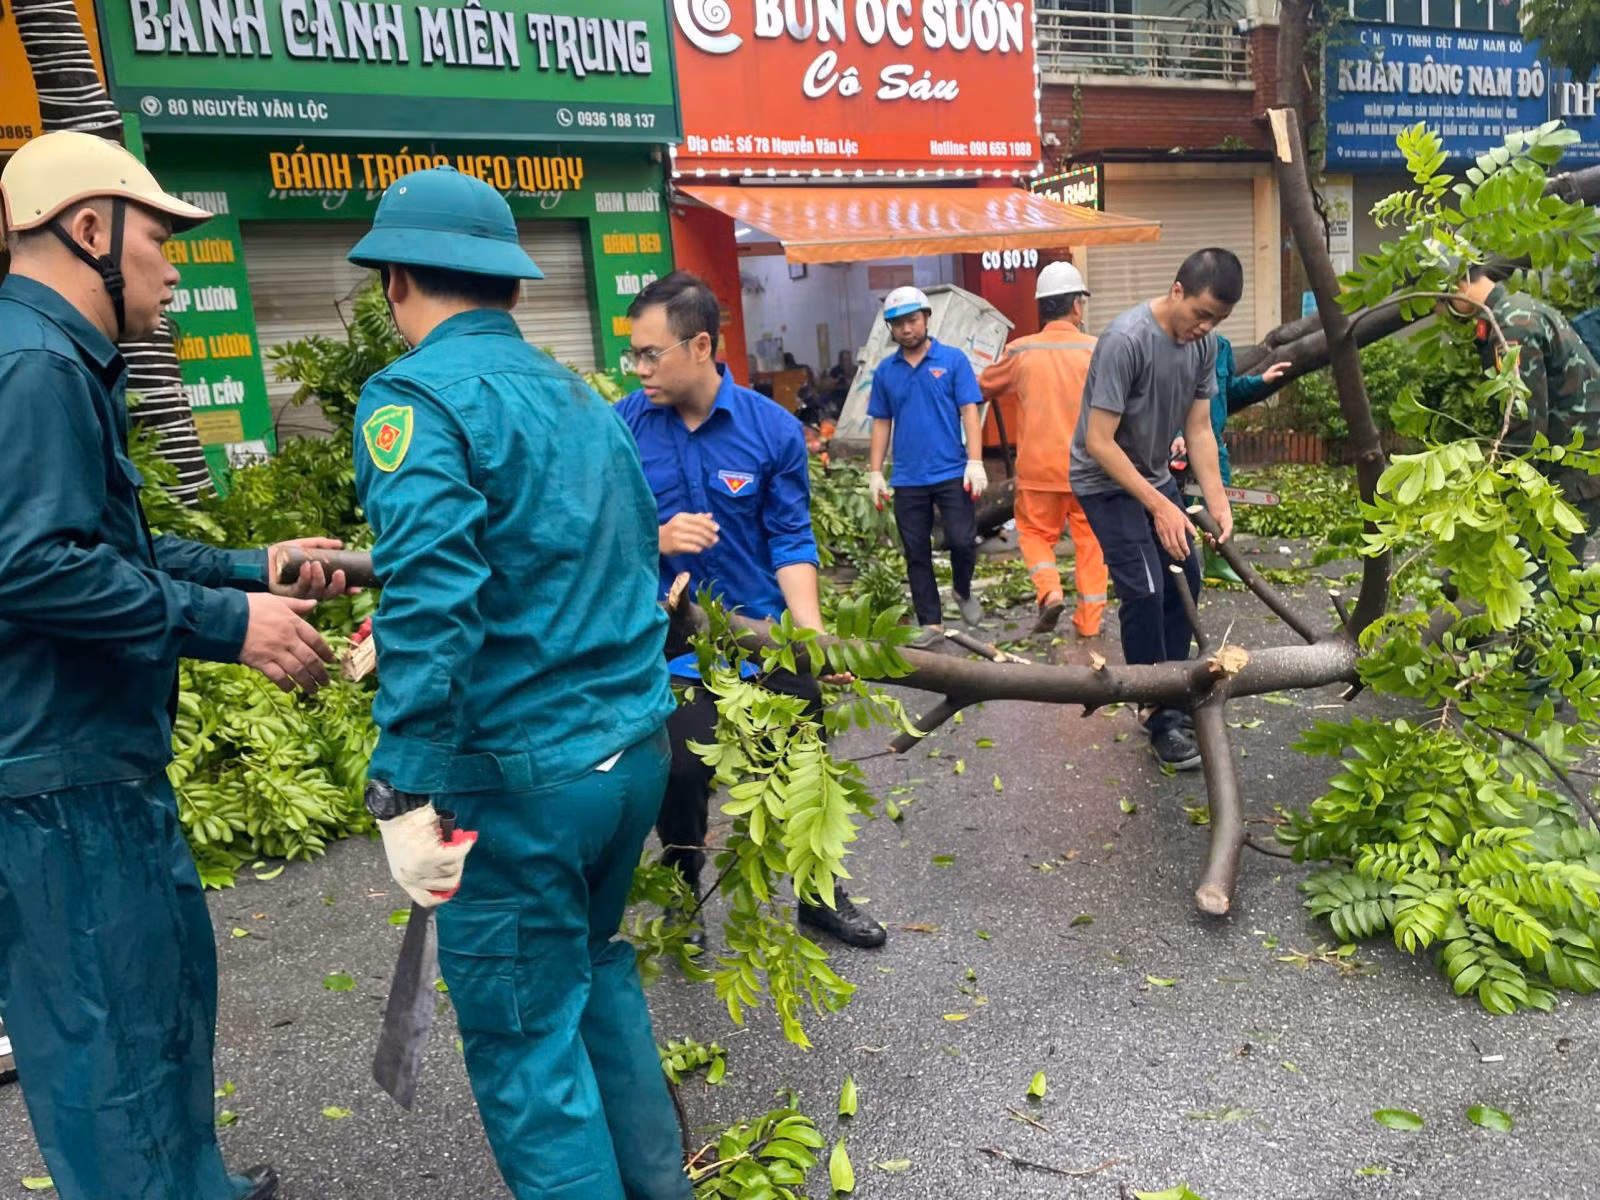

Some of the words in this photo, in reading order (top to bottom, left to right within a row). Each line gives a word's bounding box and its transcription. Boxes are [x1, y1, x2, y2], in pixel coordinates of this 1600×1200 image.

[1391, 33, 1403, 46] TY
[1407, 34, 1431, 48] TNHH
[1458, 36, 1478, 51] MAY
[1483, 39, 1505, 53] NAM
[803, 50, 862, 98] Cô
[1408, 54, 1464, 95] BÔNG
[1467, 65, 1512, 96] NAM
[1516, 60, 1545, 97] ĐÔ
[168, 99, 188, 115] 80
[262, 98, 294, 118] VĂN
[298, 99, 328, 122] LỘC
[577, 111, 607, 126] 0936
[610, 112, 632, 127] 188
[634, 113, 655, 128] 137
[754, 136, 770, 153] 78
[269, 144, 353, 190] BÁNH
[516, 156, 584, 192] QUAY
[1022, 248, 1038, 268] 19
